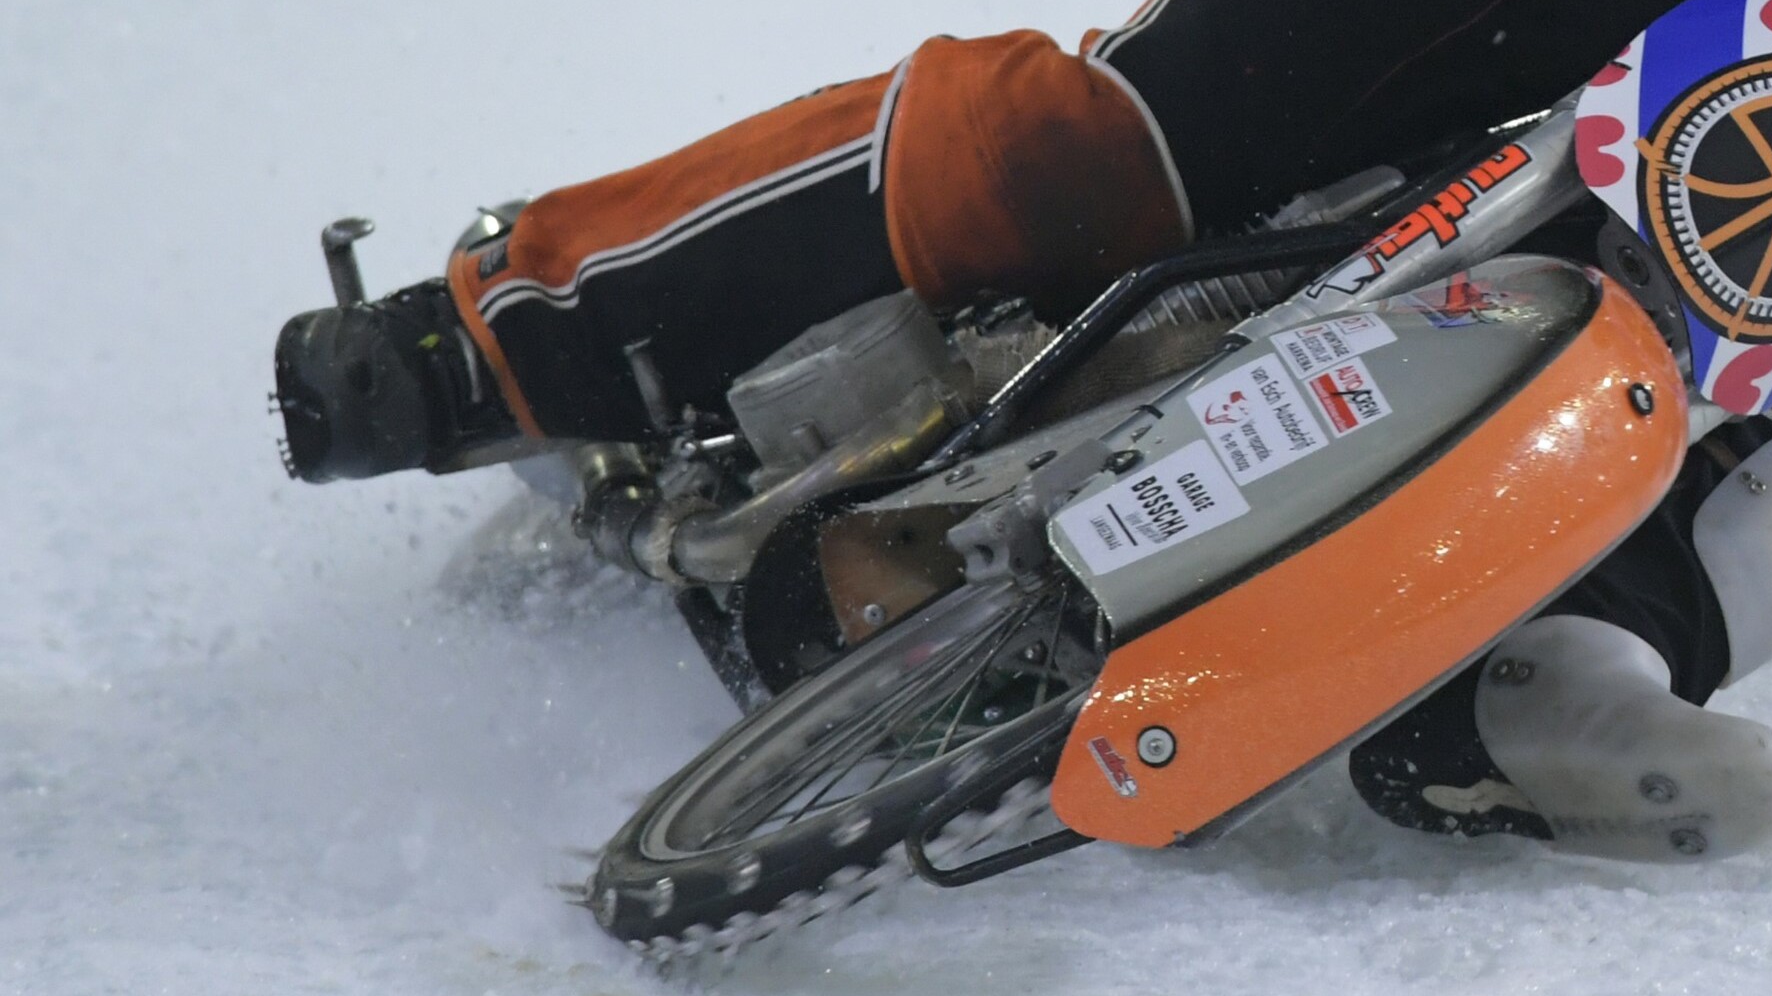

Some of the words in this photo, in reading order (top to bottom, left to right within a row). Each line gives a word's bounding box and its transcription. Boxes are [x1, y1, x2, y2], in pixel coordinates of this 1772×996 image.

[1250, 366, 1270, 385] van
[1260, 380, 1286, 405] Esch
[1273, 403, 1317, 451] Autobedrijf
[1131, 476, 1189, 539] BOSSCHA
[1176, 472, 1215, 513] GARAGE
